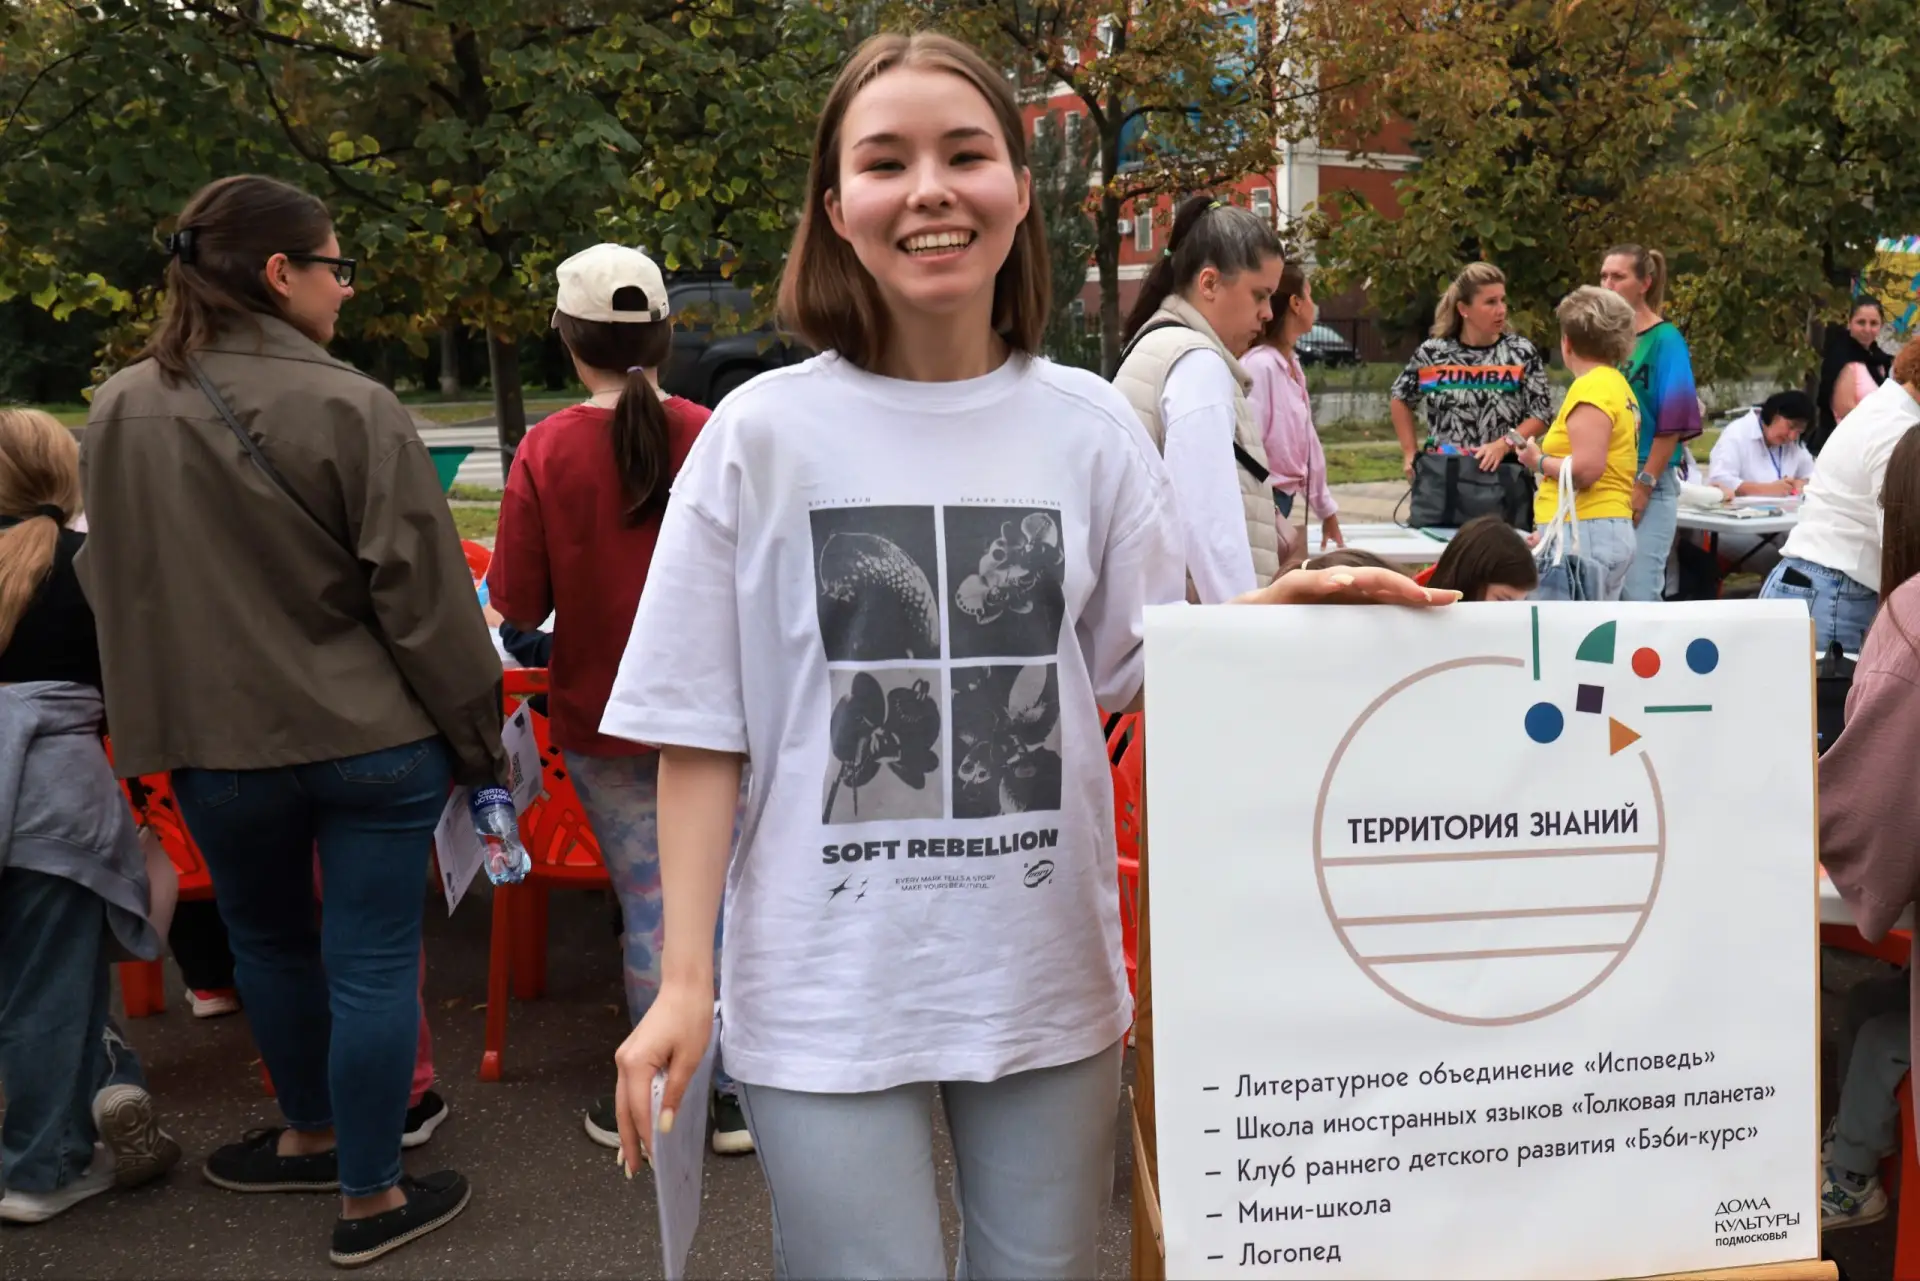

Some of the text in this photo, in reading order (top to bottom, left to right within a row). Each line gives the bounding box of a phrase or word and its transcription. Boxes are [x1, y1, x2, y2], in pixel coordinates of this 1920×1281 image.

[1435, 369, 1515, 386] ZUMBA
[1347, 802, 1638, 844] ТЕРРИТОРИЯ ЗНАНИЙ
[822, 828, 1059, 865] SOFT REBELLION
[895, 876, 920, 885] EVERY
[920, 875, 942, 883] MARK
[944, 874, 965, 882] TELLS
[1235, 1051, 1715, 1102] Литературное объединение «Исповедь»
[1236, 1086, 1776, 1140] Школа иностранных языков «Толковая планета»
[1238, 1125, 1758, 1187] Клуб раннего детского развития «Бэби-курс»
[1238, 1198, 1391, 1224] Мини-школа
[1714, 1197, 1771, 1216] ДОМА
[1714, 1212, 1800, 1233] КУЛЬТУРЫ
[1715, 1231, 1788, 1247] ПОДМОСКОВЬЯ
[1239, 1242, 1342, 1267] Логопед
